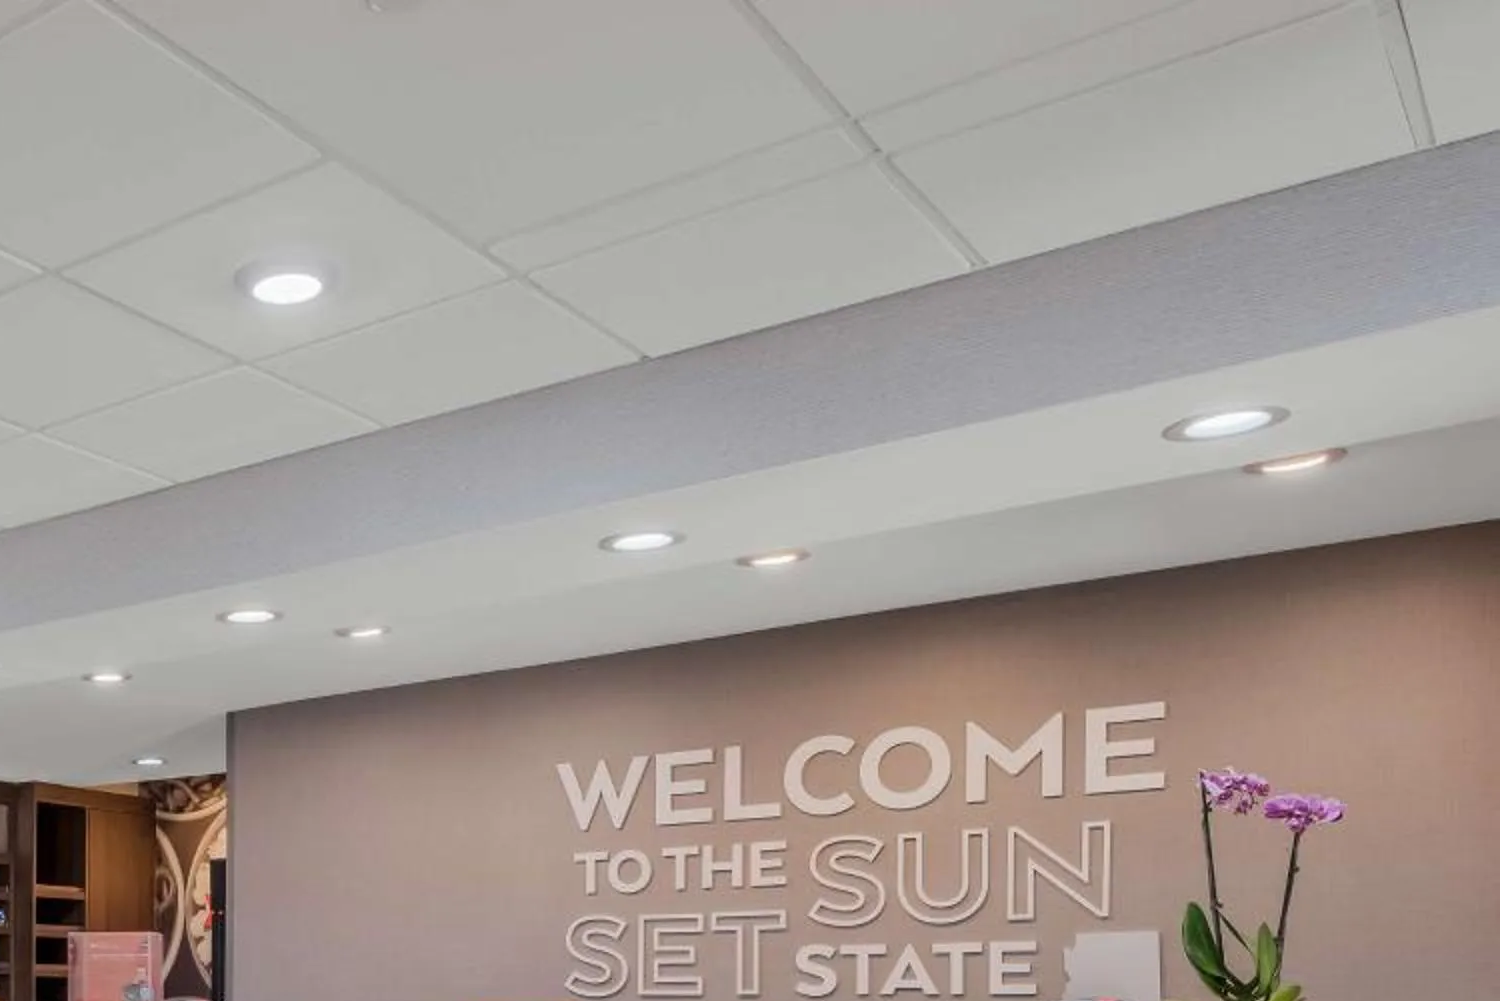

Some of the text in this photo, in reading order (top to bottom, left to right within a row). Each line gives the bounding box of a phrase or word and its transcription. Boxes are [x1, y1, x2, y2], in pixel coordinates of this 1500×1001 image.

[556, 701, 1167, 832] WELCOME
[573, 820, 1111, 928] TO THE SUN
[564, 909, 1037, 998] SET STATE
